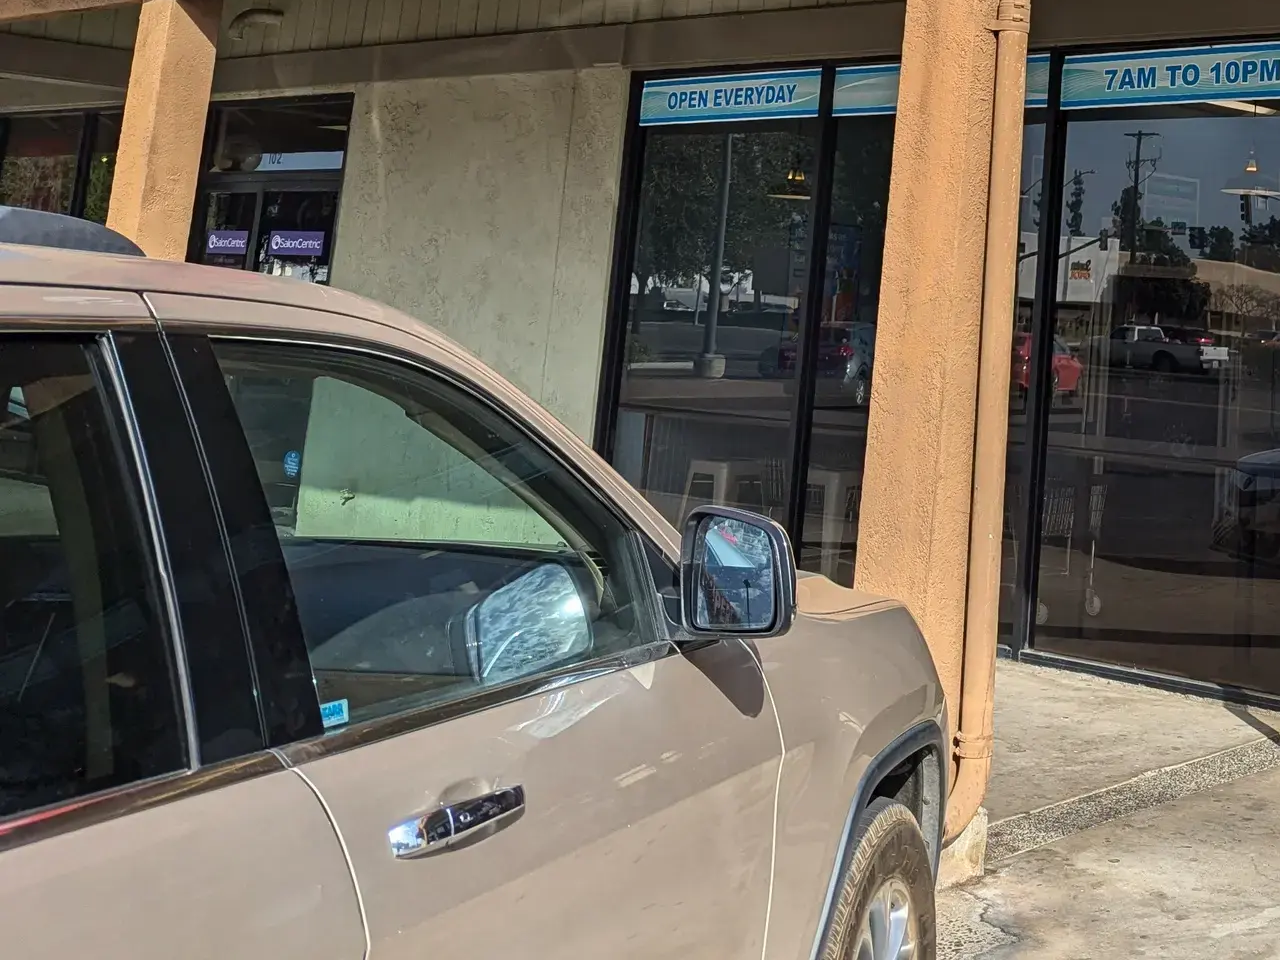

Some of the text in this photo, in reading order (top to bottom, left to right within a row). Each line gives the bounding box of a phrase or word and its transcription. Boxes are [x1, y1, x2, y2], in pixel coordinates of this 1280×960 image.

[1104, 67, 1157, 91] 7AM
[1165, 64, 1200, 87] TO
[667, 83, 798, 111] OPEN EVERYDAY
[215, 237, 246, 248] SalonCentric
[279, 238, 322, 249] SalonCentric
